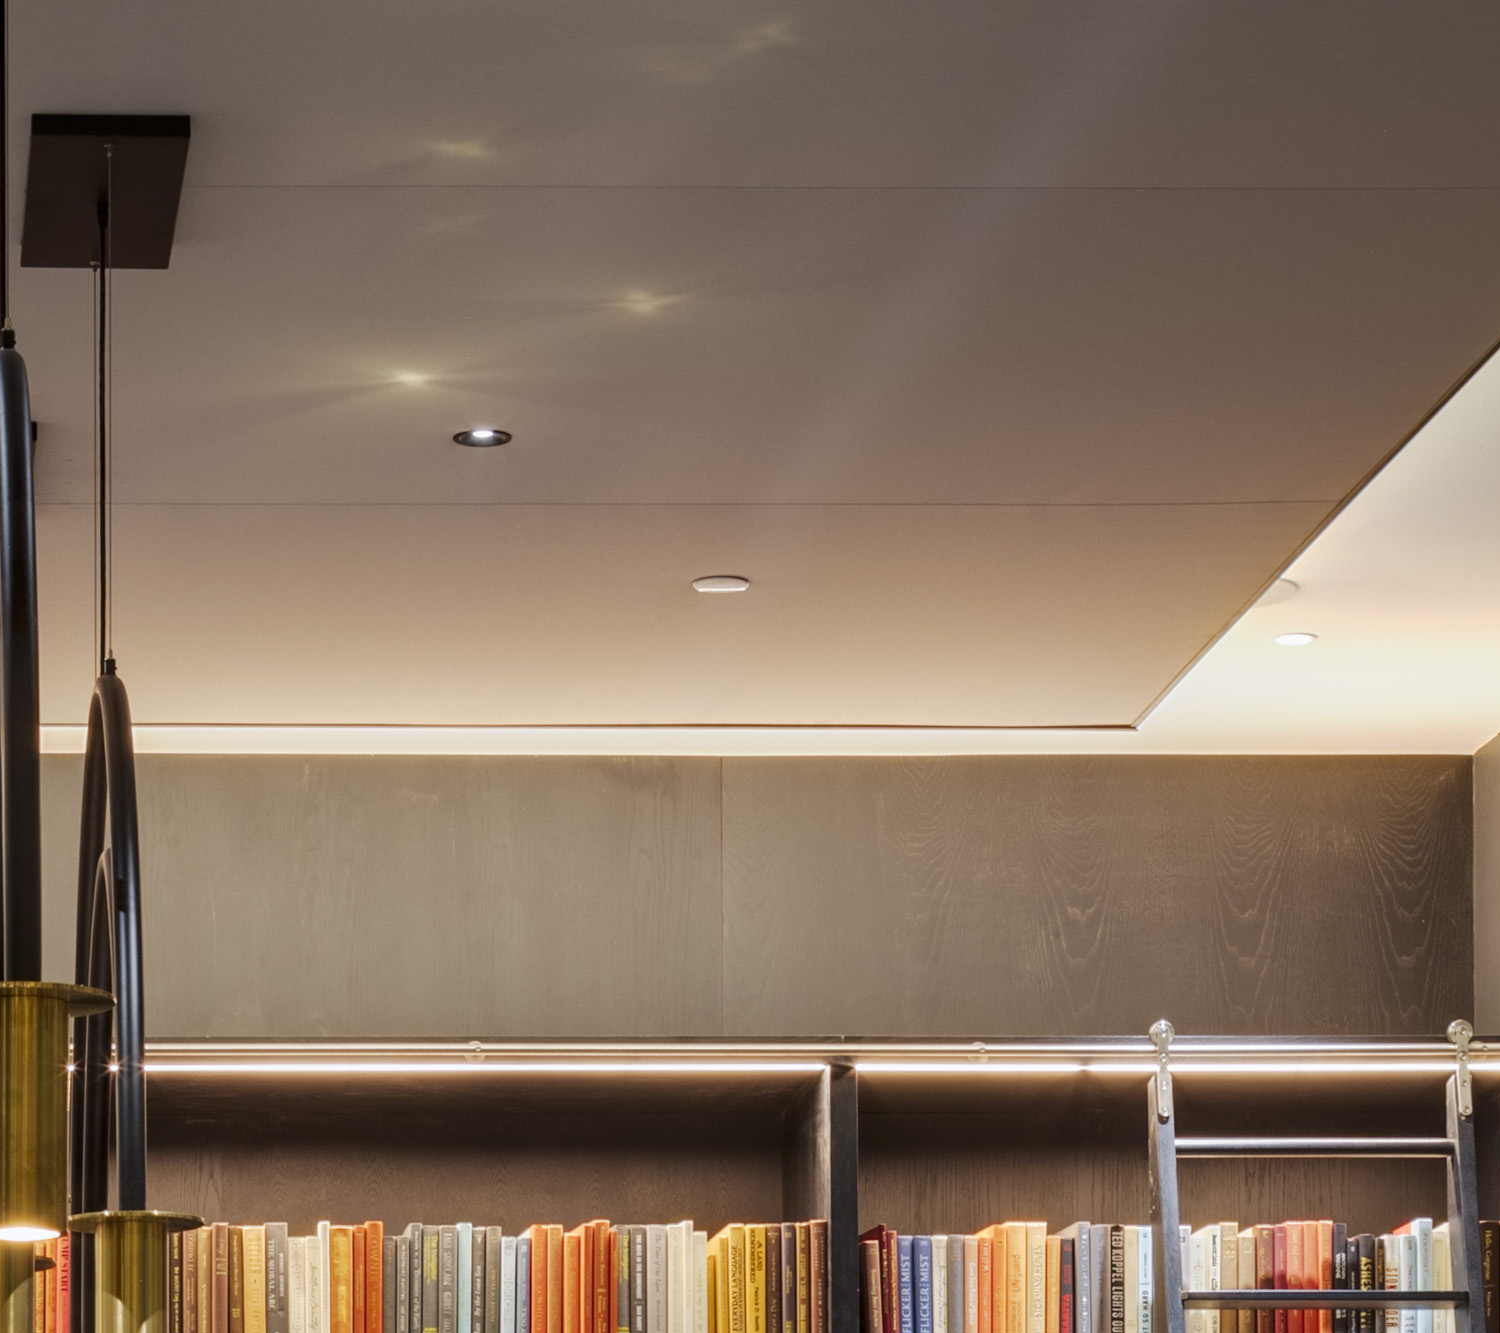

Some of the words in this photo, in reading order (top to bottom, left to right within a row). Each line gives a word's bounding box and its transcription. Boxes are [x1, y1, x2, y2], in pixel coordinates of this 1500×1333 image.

[1112, 1230, 1124, 1247] TED
[901, 1254, 911, 1282] MIST
[920, 1254, 930, 1282] MIST
[1112, 1248, 1124, 1283] KOPPEL
[1386, 1267, 1398, 1290] STON
[901, 1287, 911, 1333] FLICKER
[920, 1287, 930, 1333] FLICKER
[1112, 1286, 1124, 1319] LIGHTS
[1386, 1310, 1398, 1327] DER
